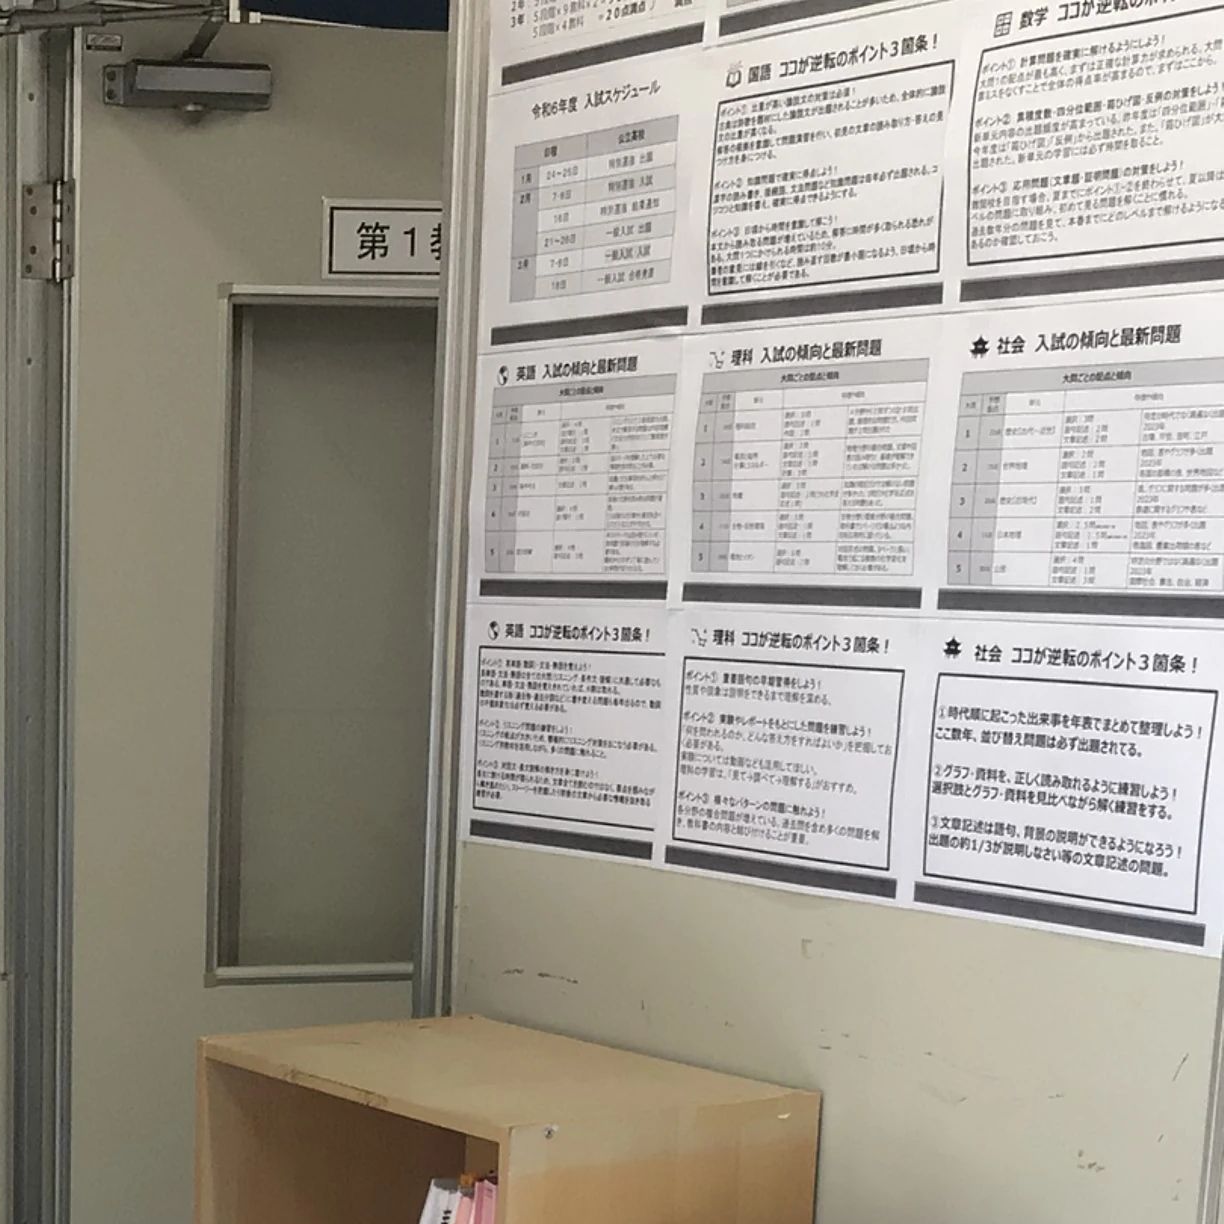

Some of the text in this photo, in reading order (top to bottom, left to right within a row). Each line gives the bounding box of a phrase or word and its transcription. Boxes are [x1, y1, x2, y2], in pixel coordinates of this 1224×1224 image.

[1019, 8, 1048, 29] 数学
[748, 63, 771, 84] 国語
[532, 80, 661, 120] 令和6年度 入試スケジュール
[997, 324, 1182, 355] 社会 入試の傾向と最新問題
[730, 339, 882, 366] 理科 入試の傾向と最新問題
[516, 356, 638, 382] 英語 入試の傾向と最新問題
[505, 623, 524, 639] 英語
[713, 629, 735, 646] 理科
[974, 644, 1003, 663] 社会
